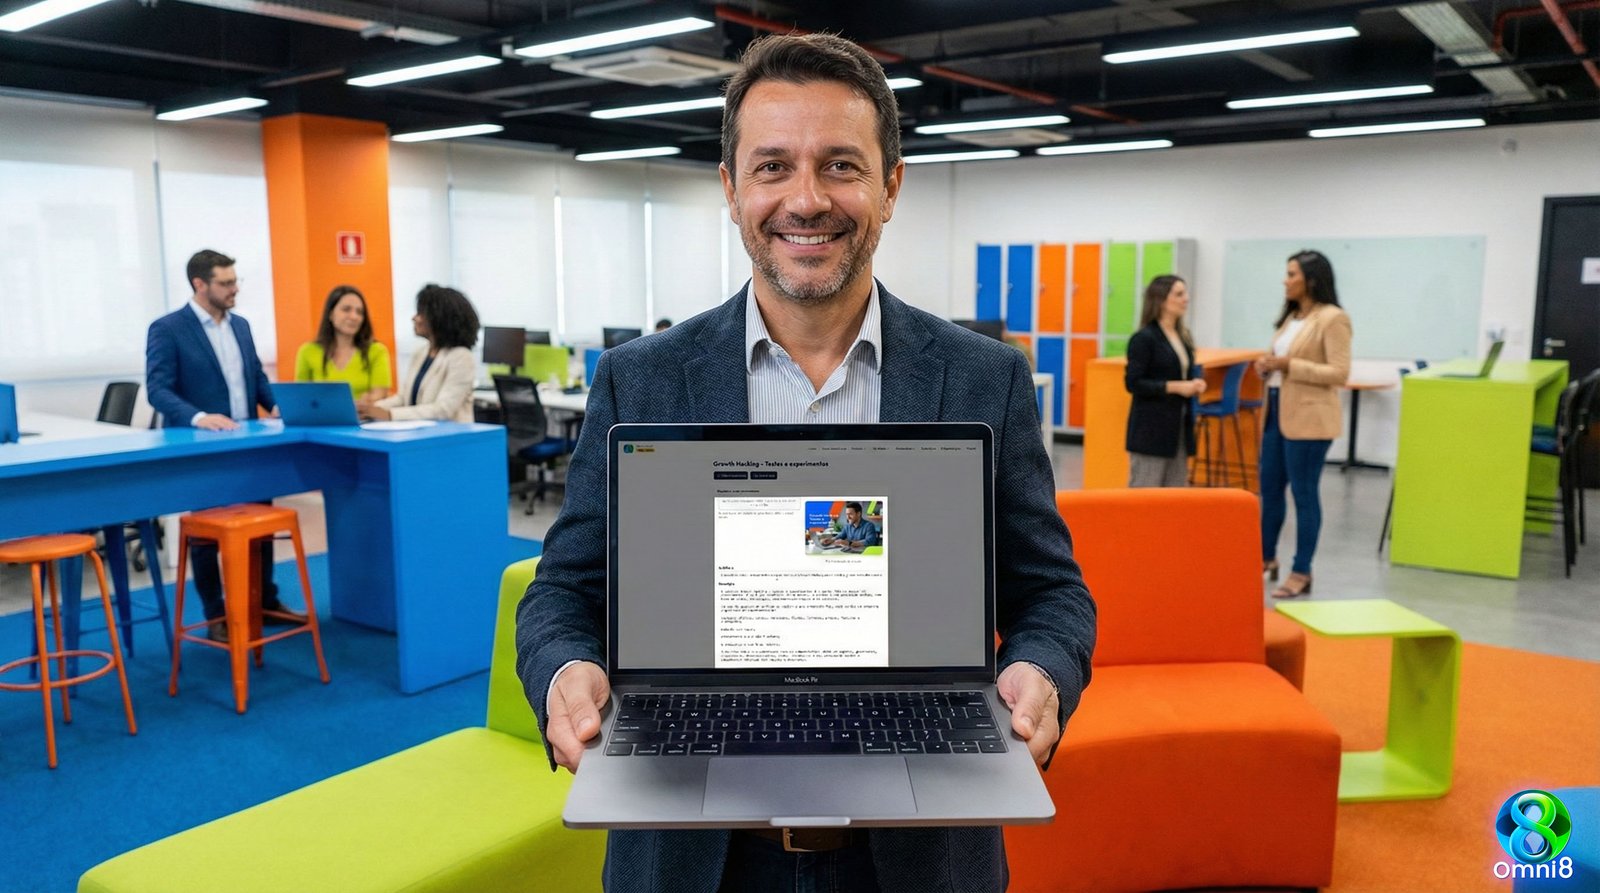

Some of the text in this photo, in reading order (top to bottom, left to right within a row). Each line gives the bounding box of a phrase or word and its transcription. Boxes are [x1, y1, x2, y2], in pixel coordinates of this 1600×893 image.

[713, 460, 735, 468] Growth
[736, 460, 760, 469] Hacking
[765, 460, 783, 468] Testes
[789, 460, 829, 469] experimentos
